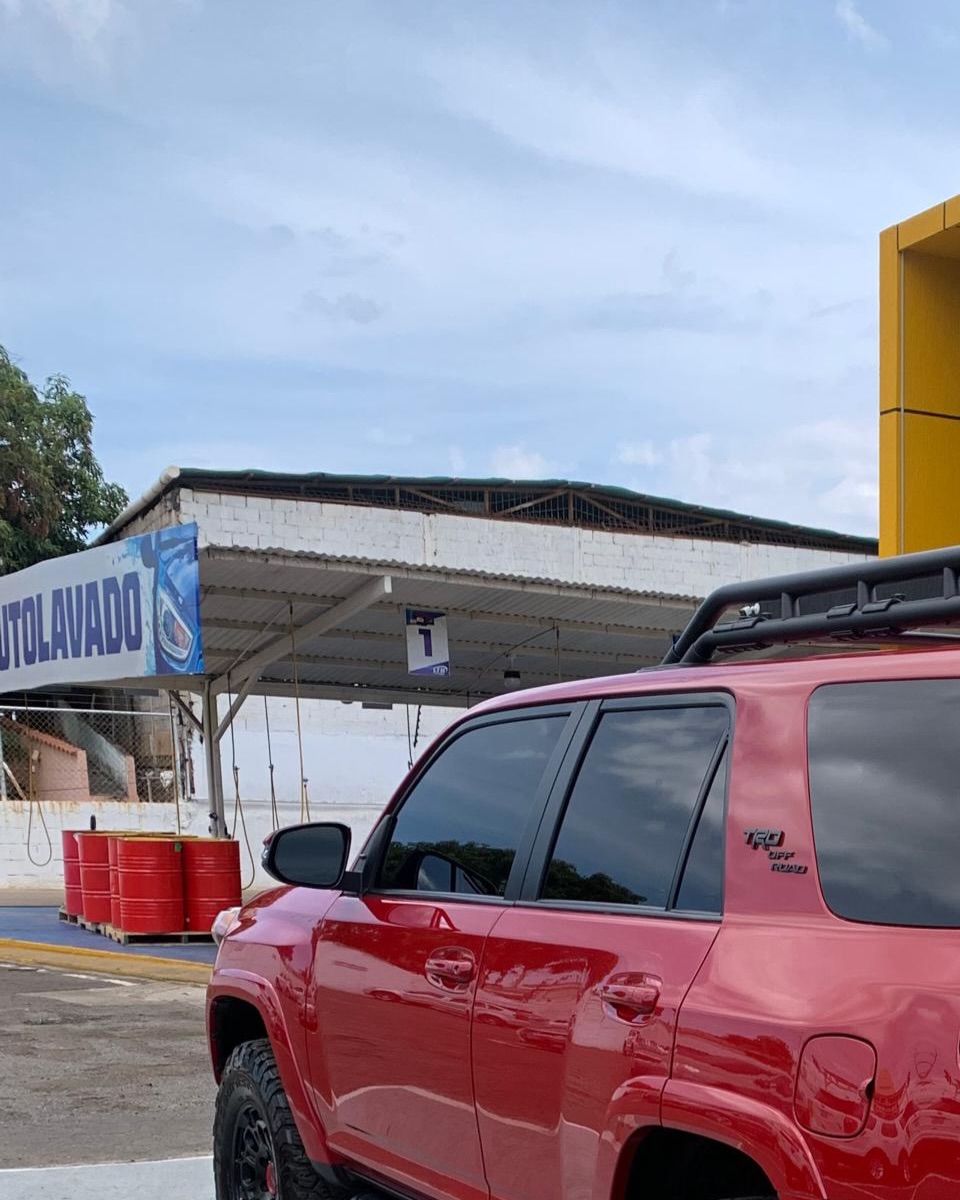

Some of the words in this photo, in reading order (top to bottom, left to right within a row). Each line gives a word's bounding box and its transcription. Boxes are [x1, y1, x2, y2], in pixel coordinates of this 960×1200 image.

[418, 628, 433, 657] 1
[744, 828, 785, 851] TRD
[768, 851, 796, 861] OFF
[771, 863, 808, 875] ROAD
